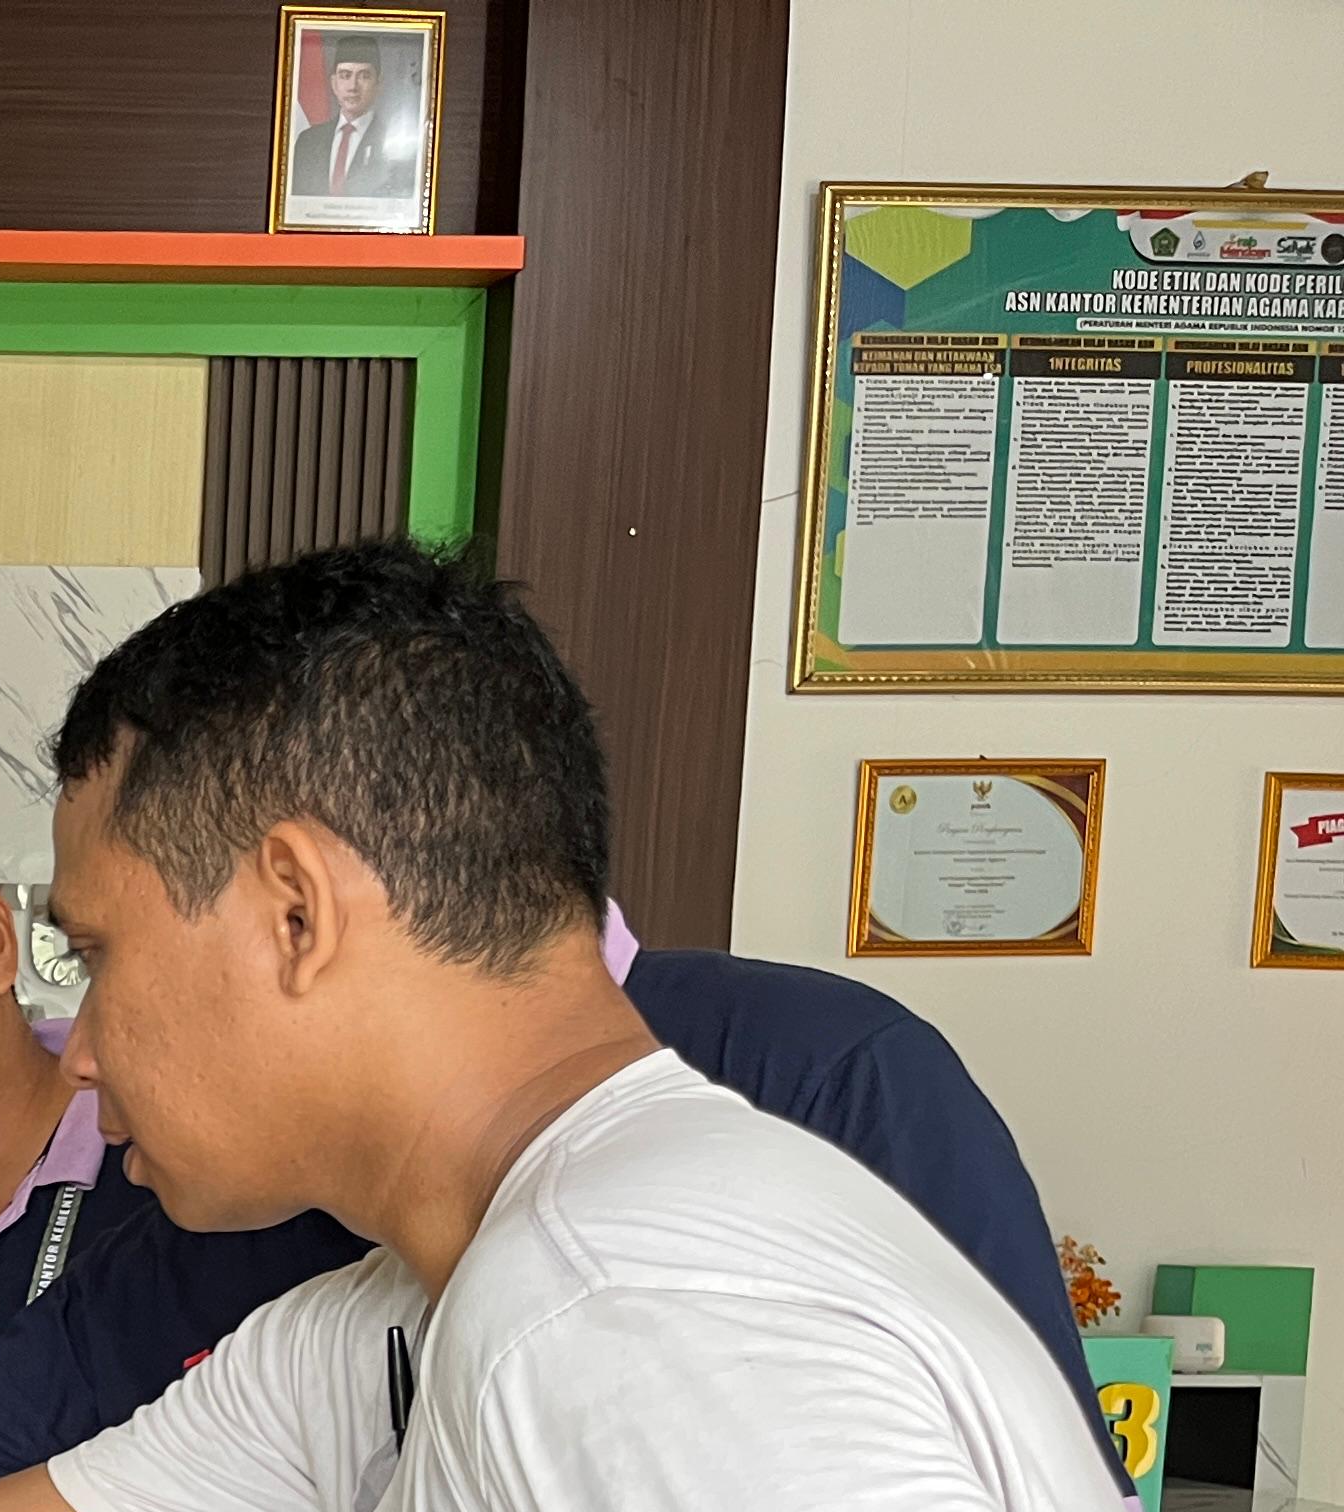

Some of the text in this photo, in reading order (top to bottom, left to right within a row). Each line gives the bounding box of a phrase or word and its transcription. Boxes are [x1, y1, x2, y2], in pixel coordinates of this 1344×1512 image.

[1113, 270, 1158, 290] KODE
[1162, 271, 1201, 291] ETIK
[1206, 272, 1241, 292] DAN
[1245, 273, 1291, 293] KODE
[1005, 292, 1041, 312] ASN
[1045, 292, 1116, 314] KANTOR
[1121, 294, 1243, 317] KEMENTERIAN
[1247, 297, 1309, 318] AGAMA
[1187, 361, 1295, 376] PROFESIONALITAS
[1098, 1383, 1161, 1480] 3
